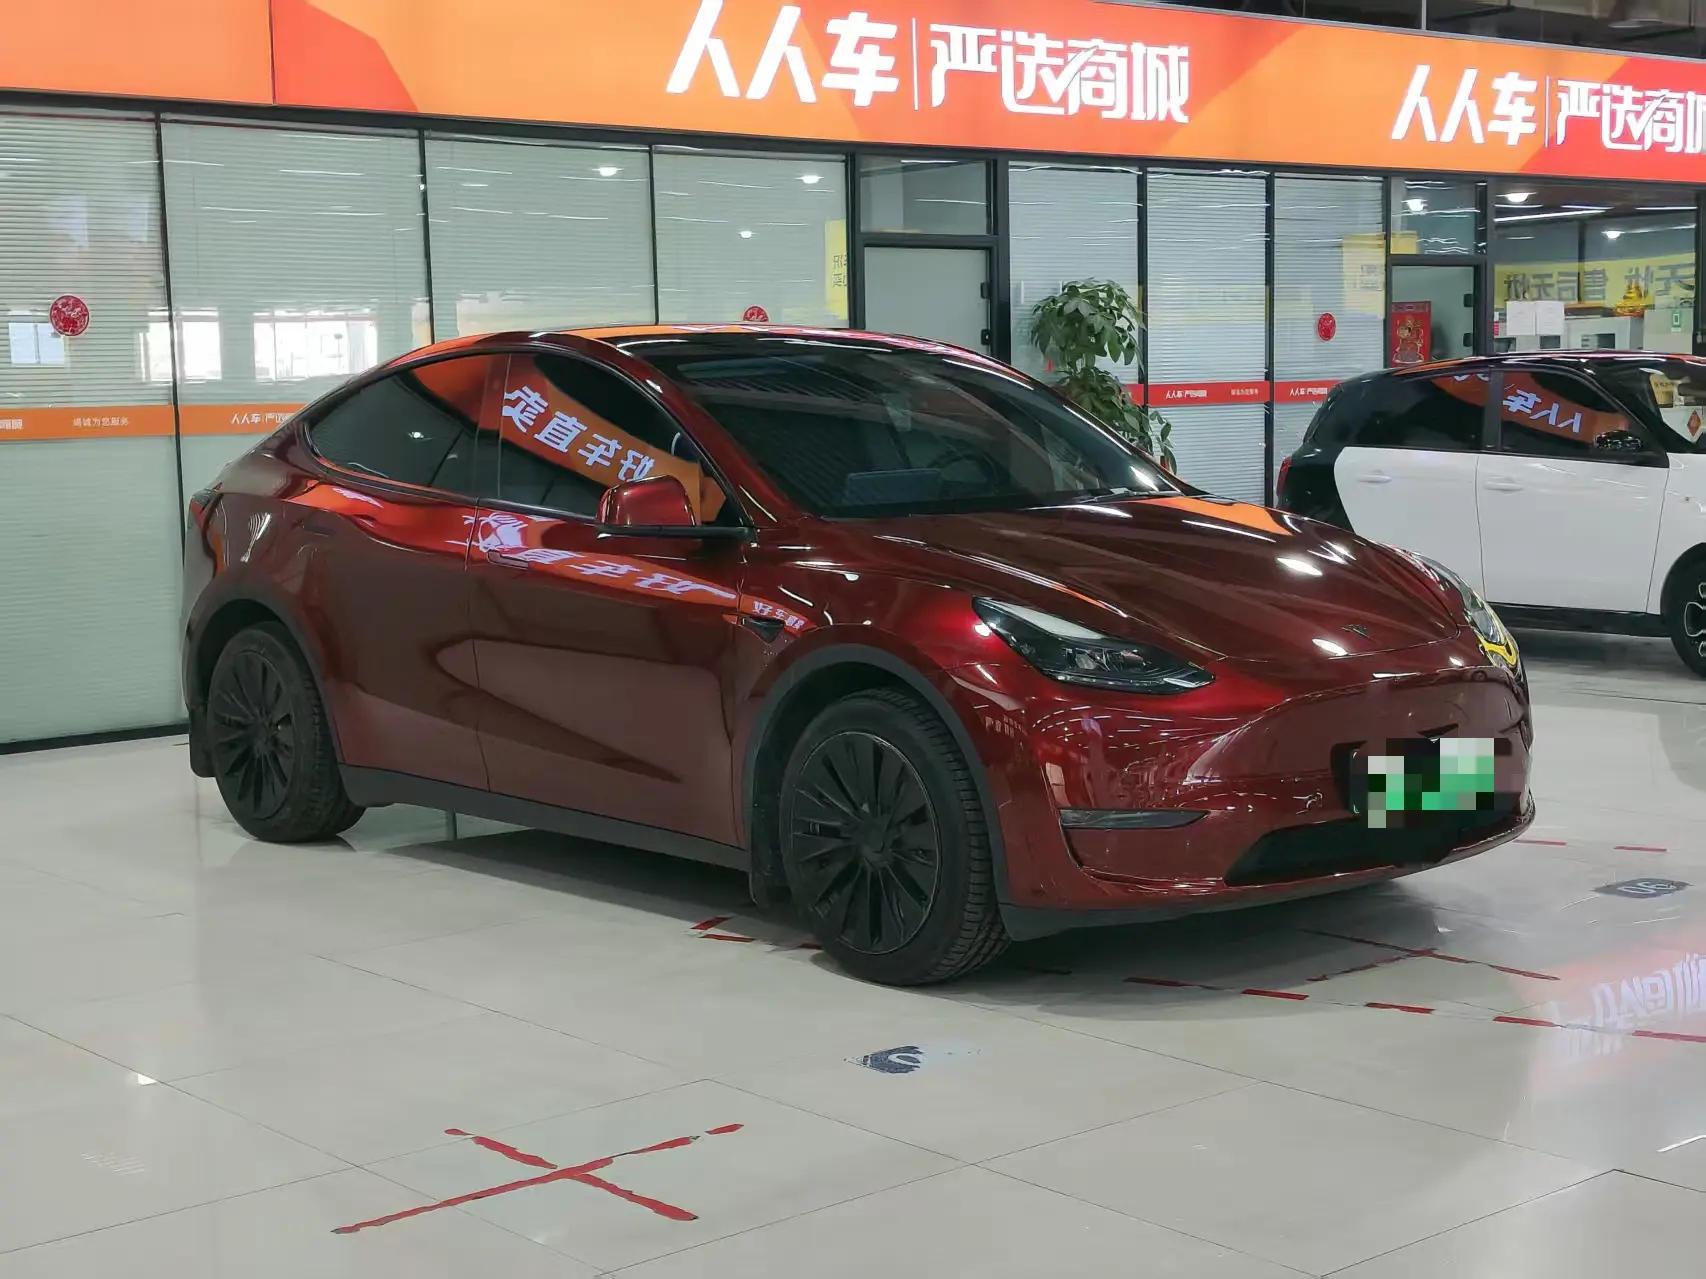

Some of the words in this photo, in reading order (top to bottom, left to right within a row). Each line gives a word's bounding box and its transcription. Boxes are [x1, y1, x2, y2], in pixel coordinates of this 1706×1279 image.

[666, 0, 899, 107] 人人车
[930, 23, 1189, 123] 严选商城
[1391, 64, 1538, 146] 人人车
[230, 413, 260, 424] 人人车
